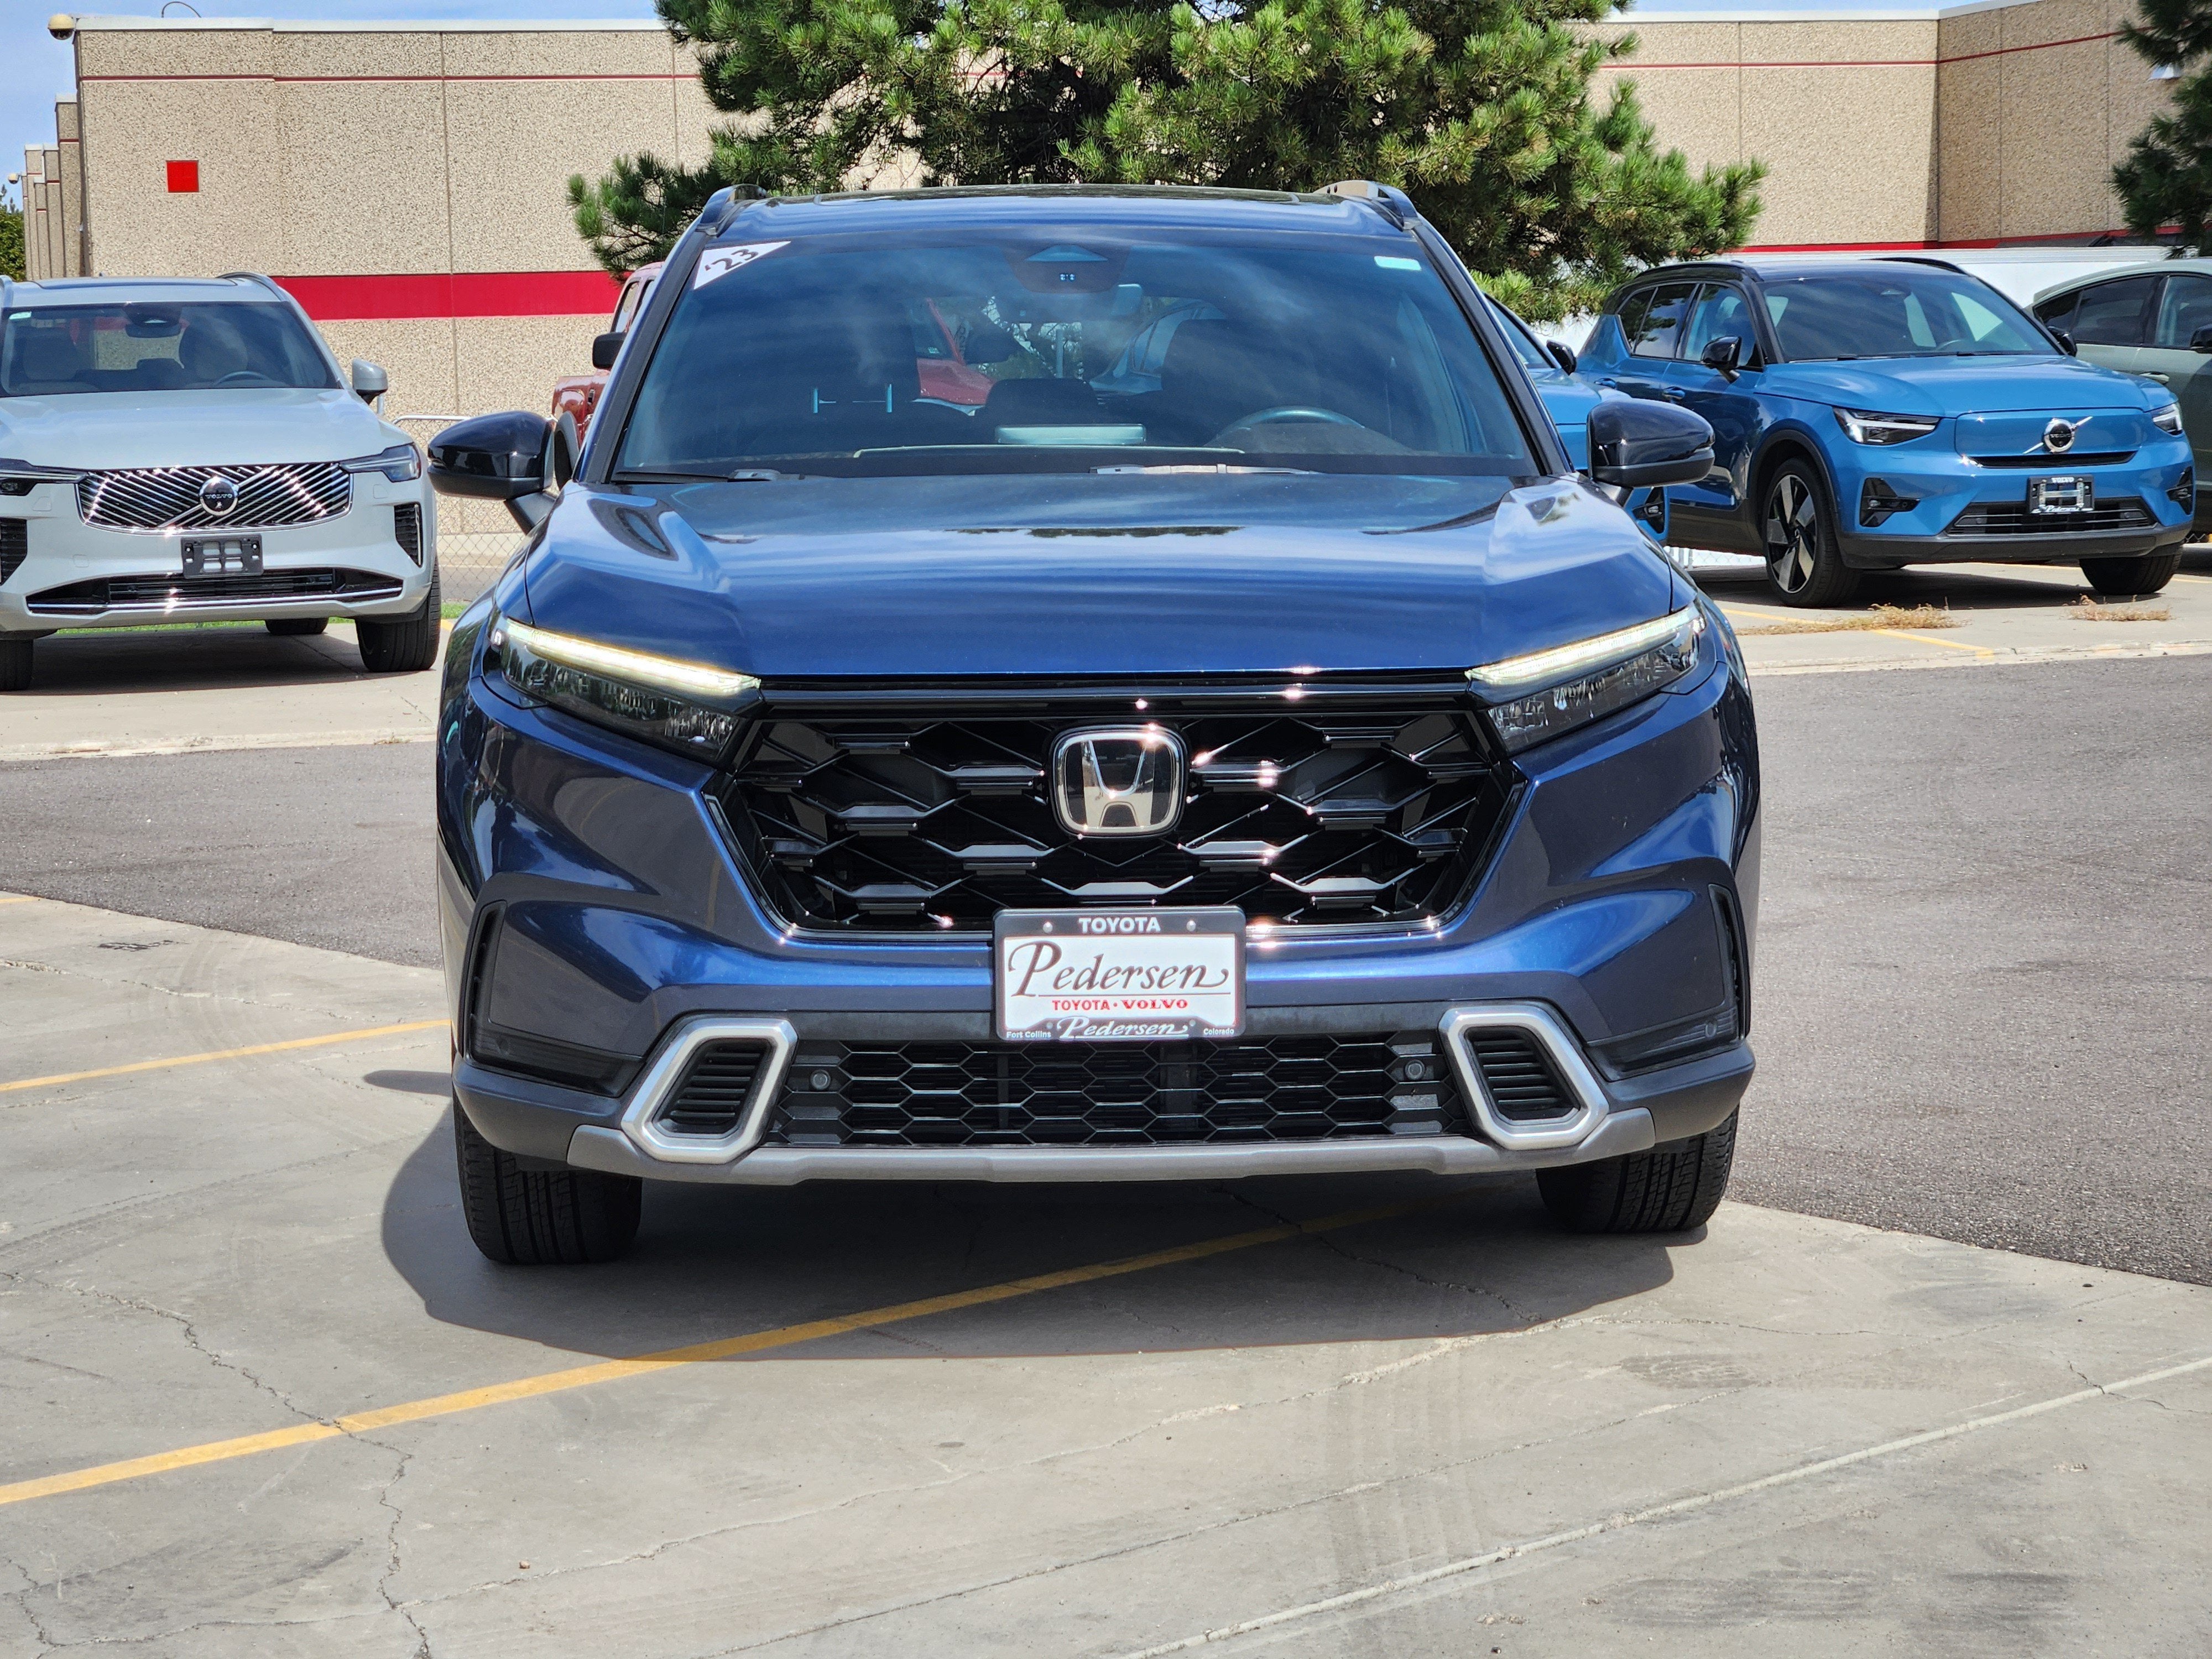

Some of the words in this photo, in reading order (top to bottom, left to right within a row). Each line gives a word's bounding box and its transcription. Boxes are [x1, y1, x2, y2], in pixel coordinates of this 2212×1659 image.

[1078, 917, 1161, 934] TOYOTA
[1008, 941, 1229, 997] Pedersen
[1052, 999, 1110, 1011] TOYOTA
[1121, 999, 1188, 1010] VOLVO
[1025, 1030, 1051, 1039] Collins
[1057, 1016, 1188, 1039] Pedersen
